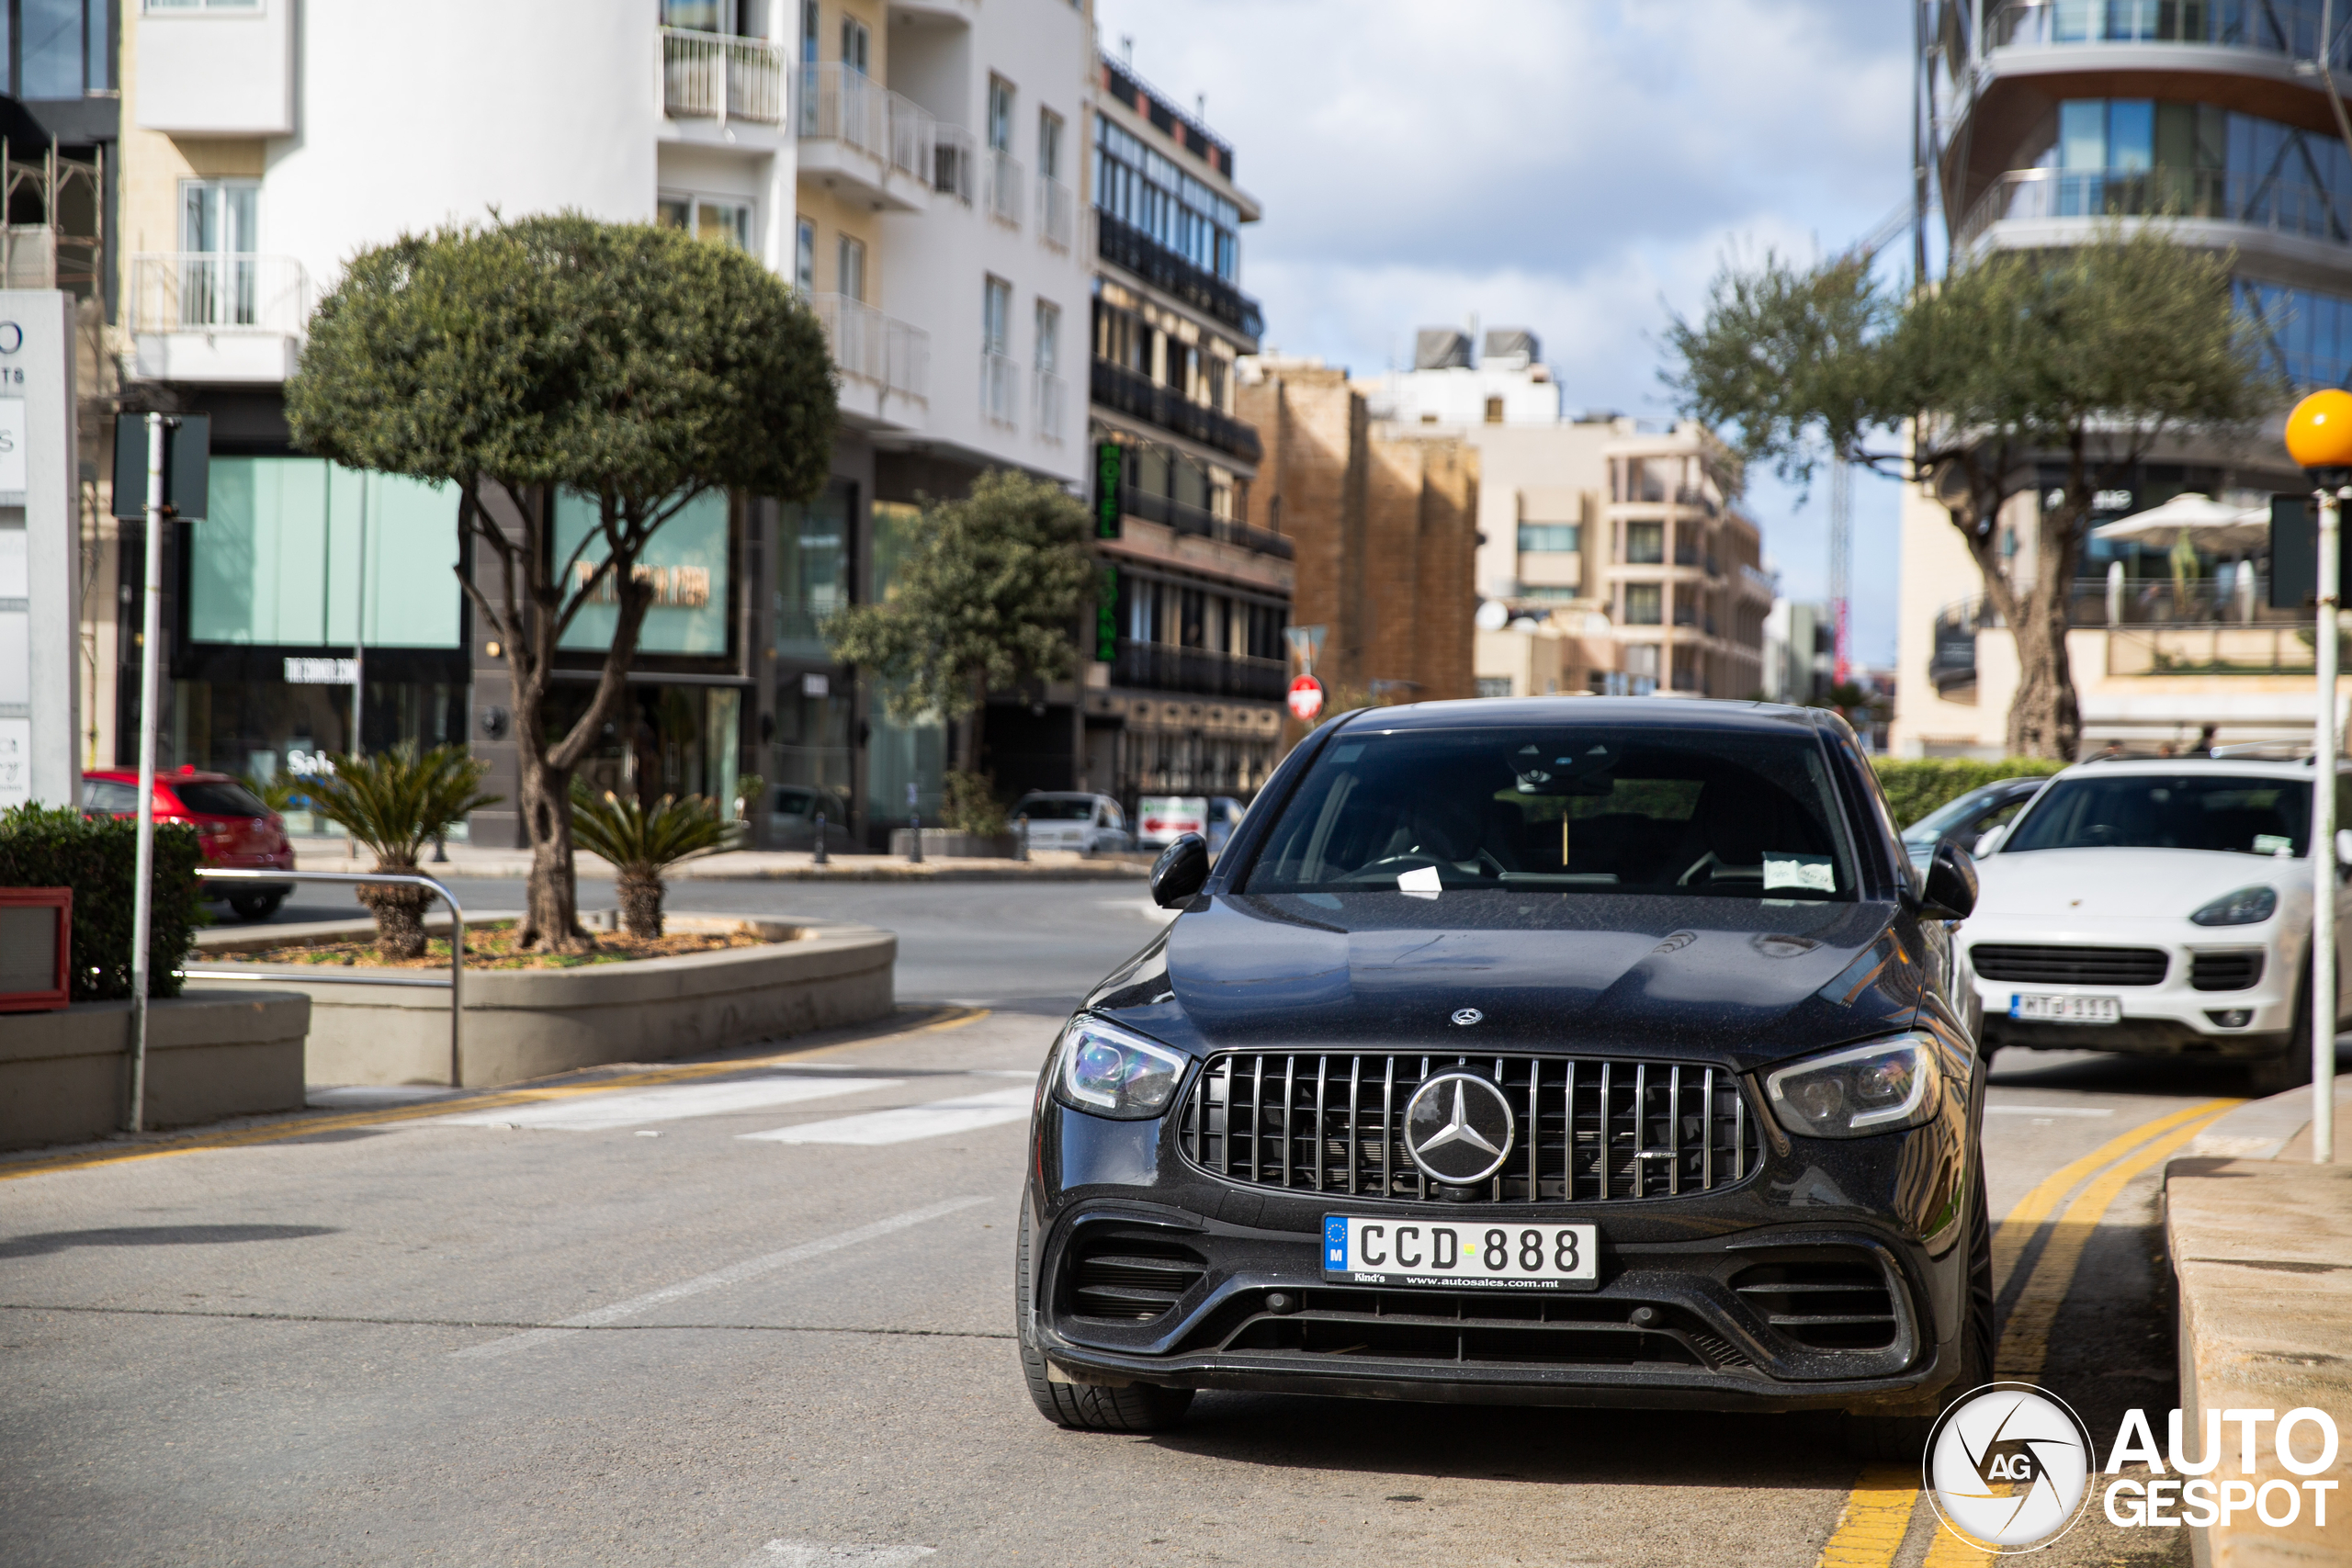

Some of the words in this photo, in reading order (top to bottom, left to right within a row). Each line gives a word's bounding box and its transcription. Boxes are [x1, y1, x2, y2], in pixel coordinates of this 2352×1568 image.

[1100, 443, 1121, 538] HOTEL
[1329, 1249, 1342, 1262] M
[1361, 1224, 1458, 1269] CCD
[1483, 1228, 1579, 1272] 888
[1354, 1273, 1385, 1283] Kind's
[1407, 1277, 1559, 1288] www.autosales.com.mt
